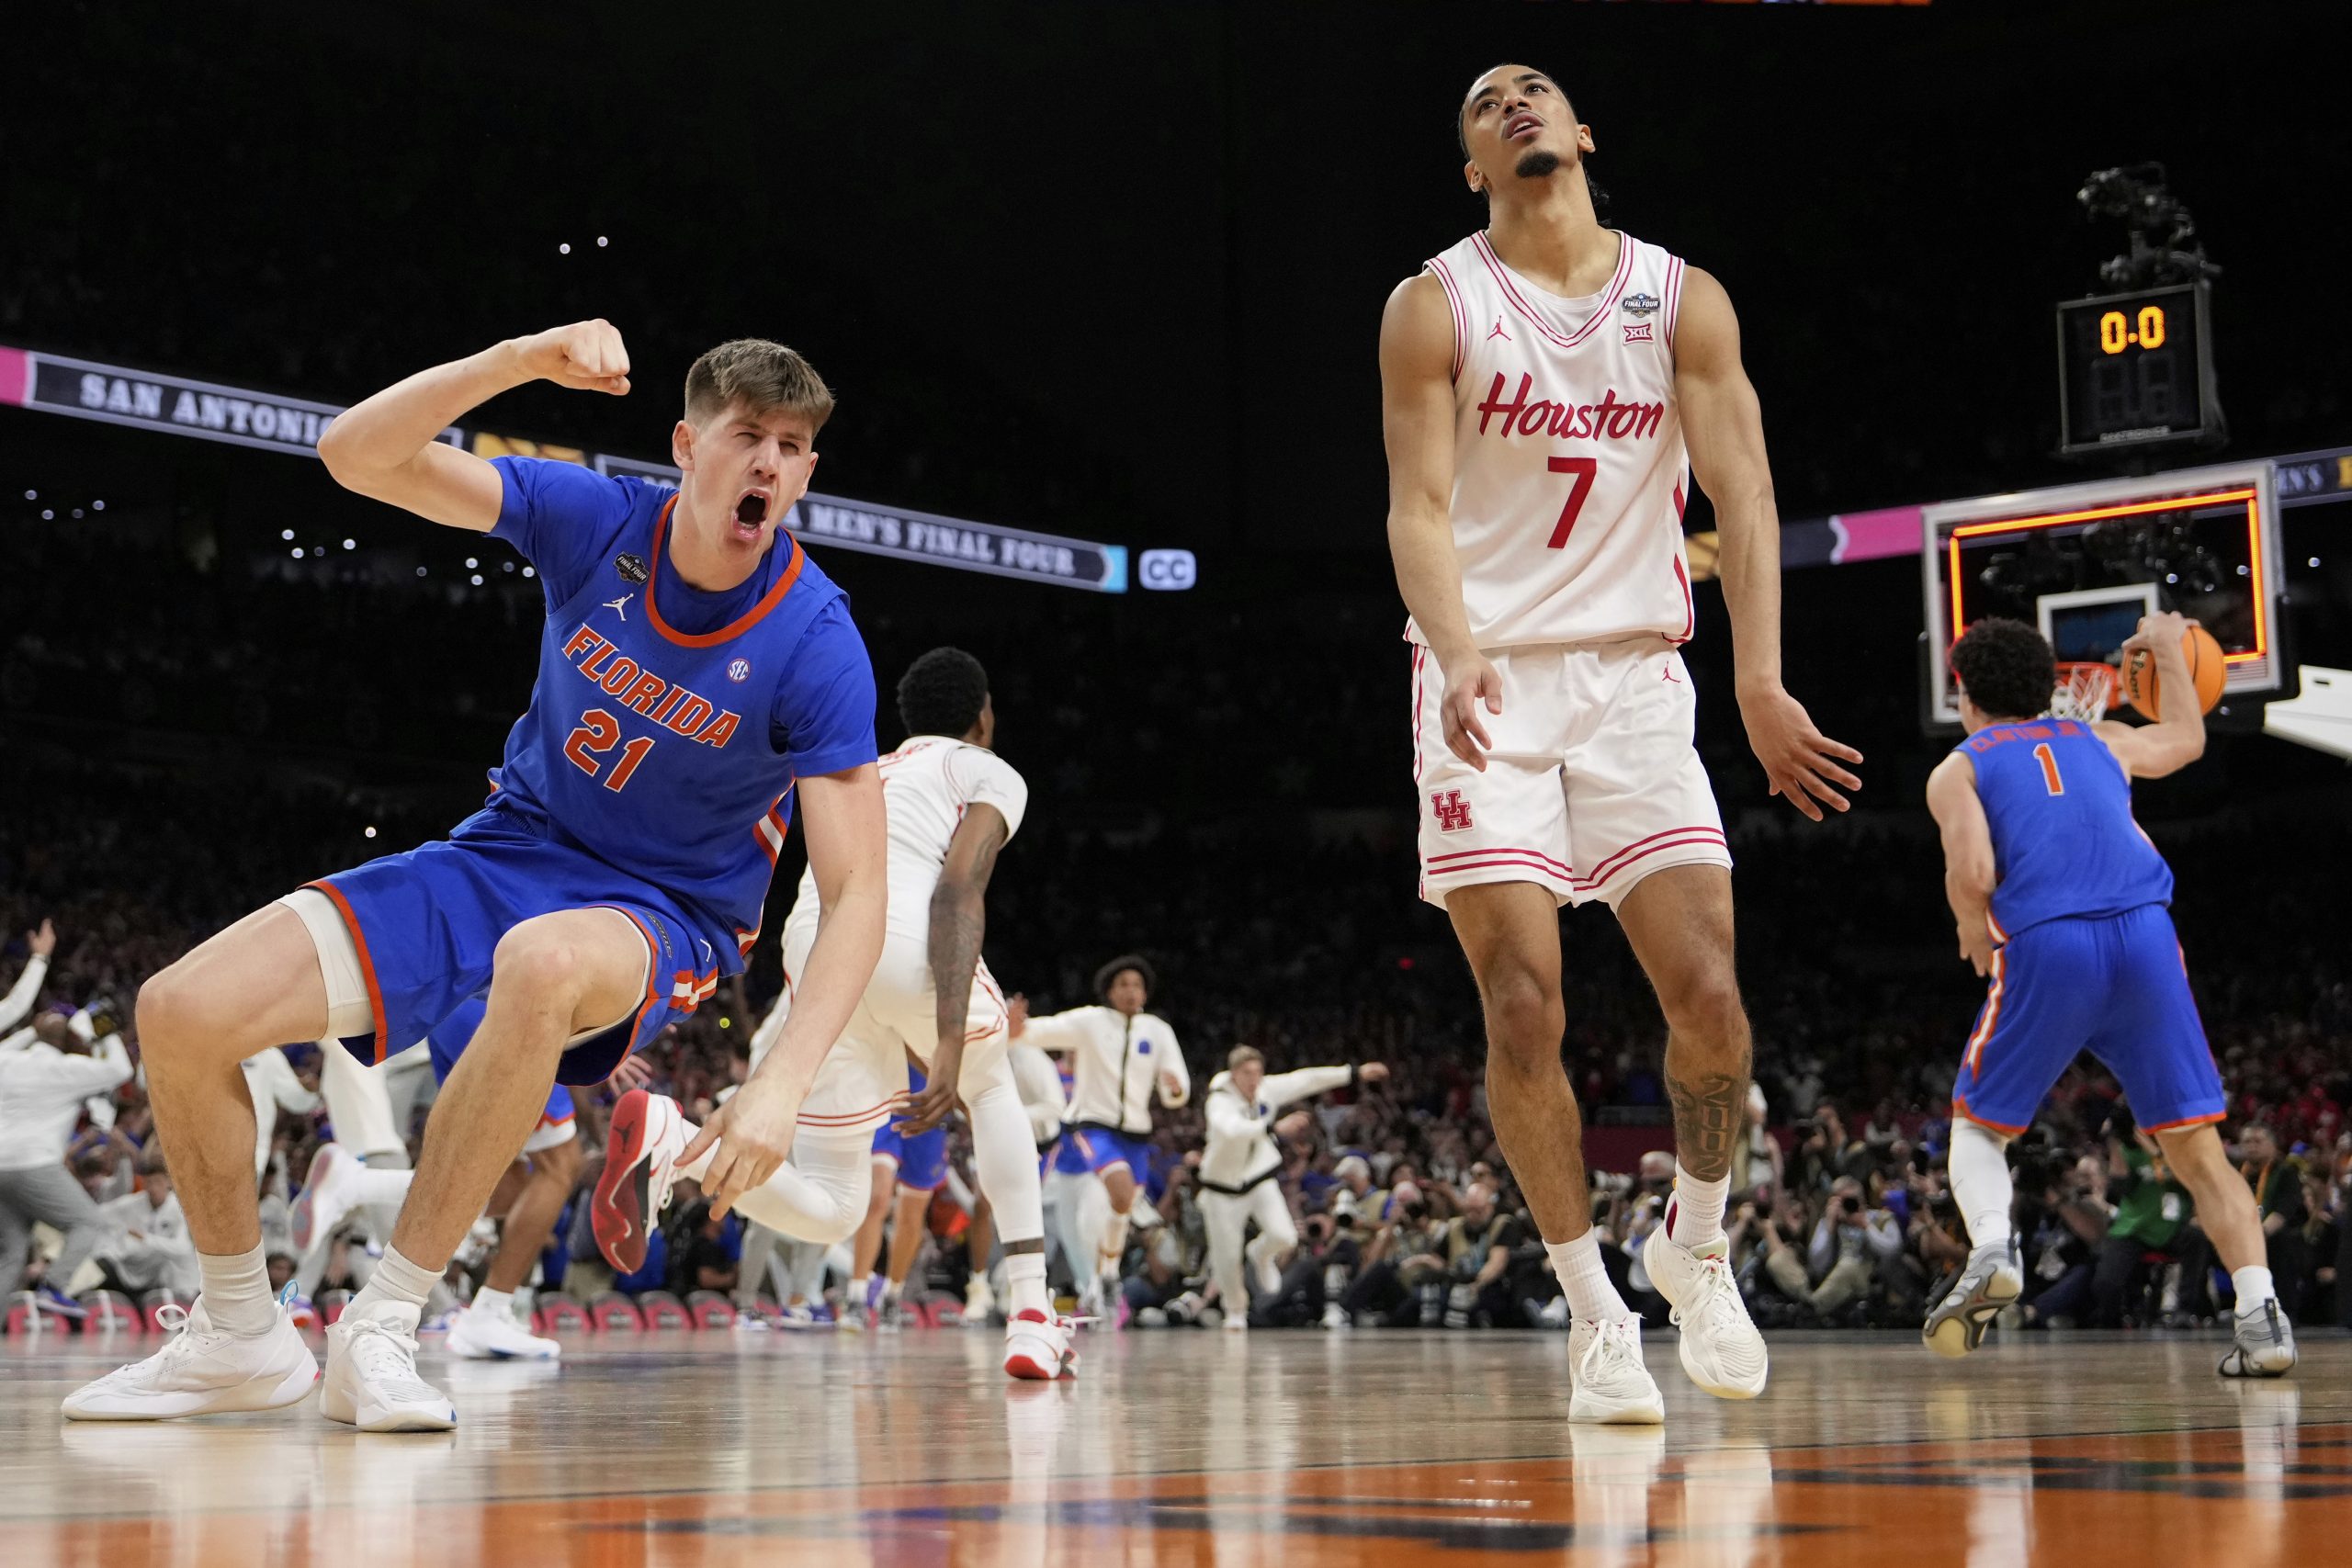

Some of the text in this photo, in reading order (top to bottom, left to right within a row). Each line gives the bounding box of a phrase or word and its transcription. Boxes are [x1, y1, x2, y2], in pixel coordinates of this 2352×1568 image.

[2100, 306, 2165, 355] 0.0
[80, 373, 164, 418] SAN
[1477, 371, 1664, 441] Houston
[1547, 456, 1597, 549] 7
[809, 503, 901, 547] MEN'S
[907, 521, 996, 563] FINAL
[1001, 537, 1076, 577] FOUR
[617, 556, 647, 581] FINAL FOUR
[1148, 558, 1187, 581] CC
[561, 623, 741, 749] FLORIDA
[729, 660, 749, 681] SEC
[563, 708, 655, 793] 21
[2033, 742, 2064, 796] 1
